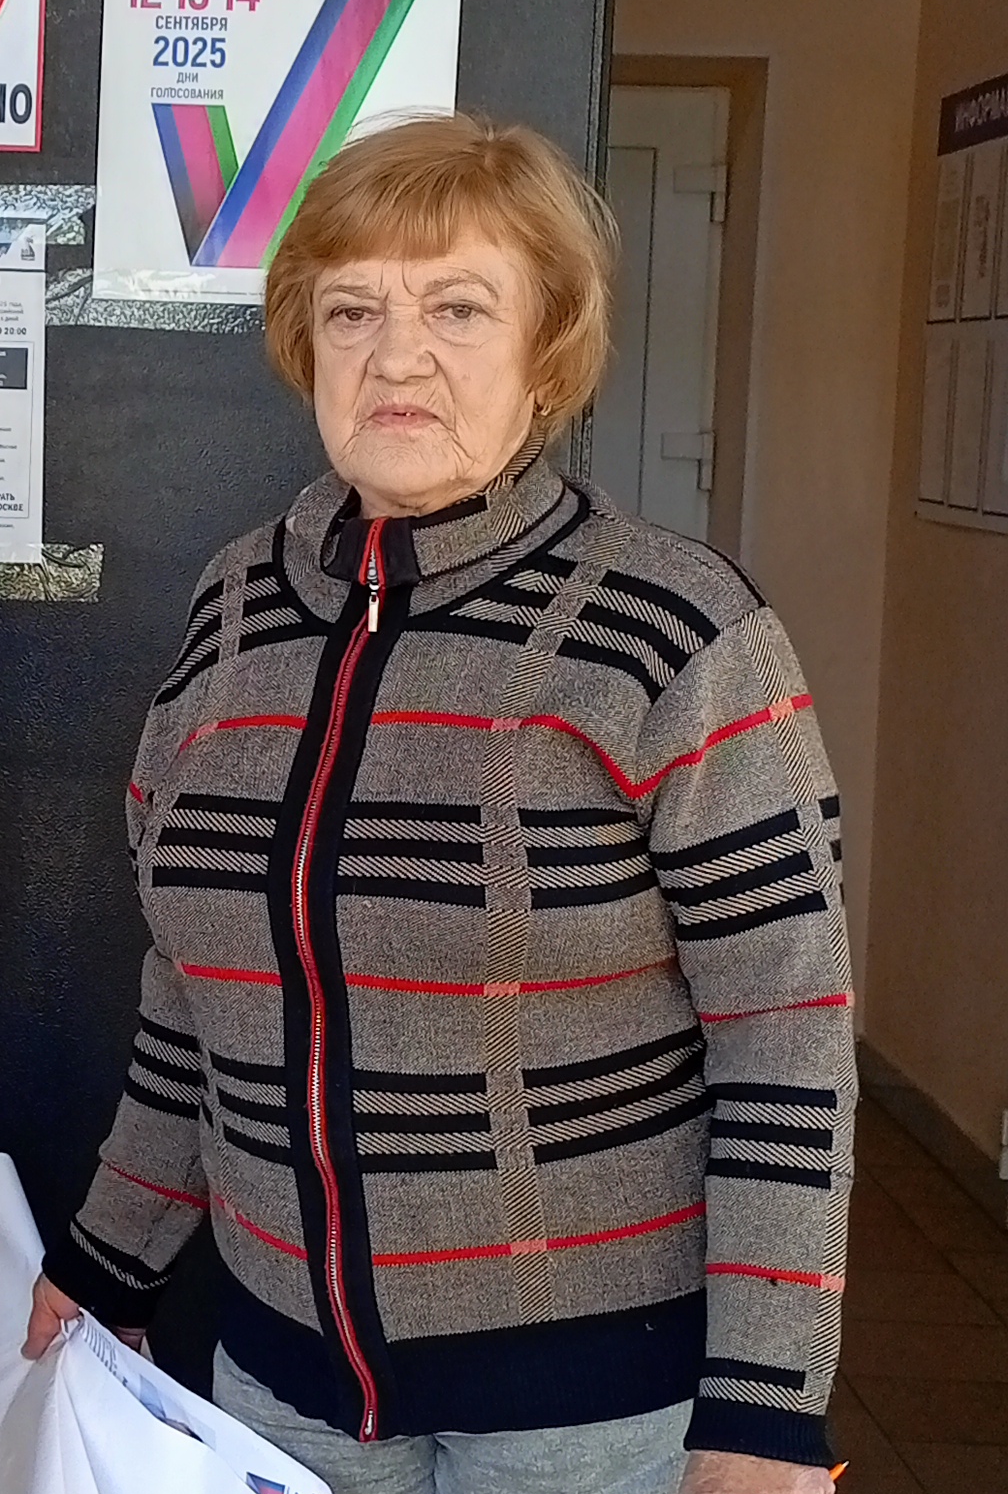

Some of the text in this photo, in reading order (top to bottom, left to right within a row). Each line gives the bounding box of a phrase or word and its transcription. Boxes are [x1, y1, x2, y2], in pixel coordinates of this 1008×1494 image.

[155, 15, 228, 31] СЕНТЯБРЯ
[153, 36, 226, 68] 2025
[176, 72, 198, 84] ДНИ
[150, 87, 224, 100] ГОЛОСОВАНИЯ
